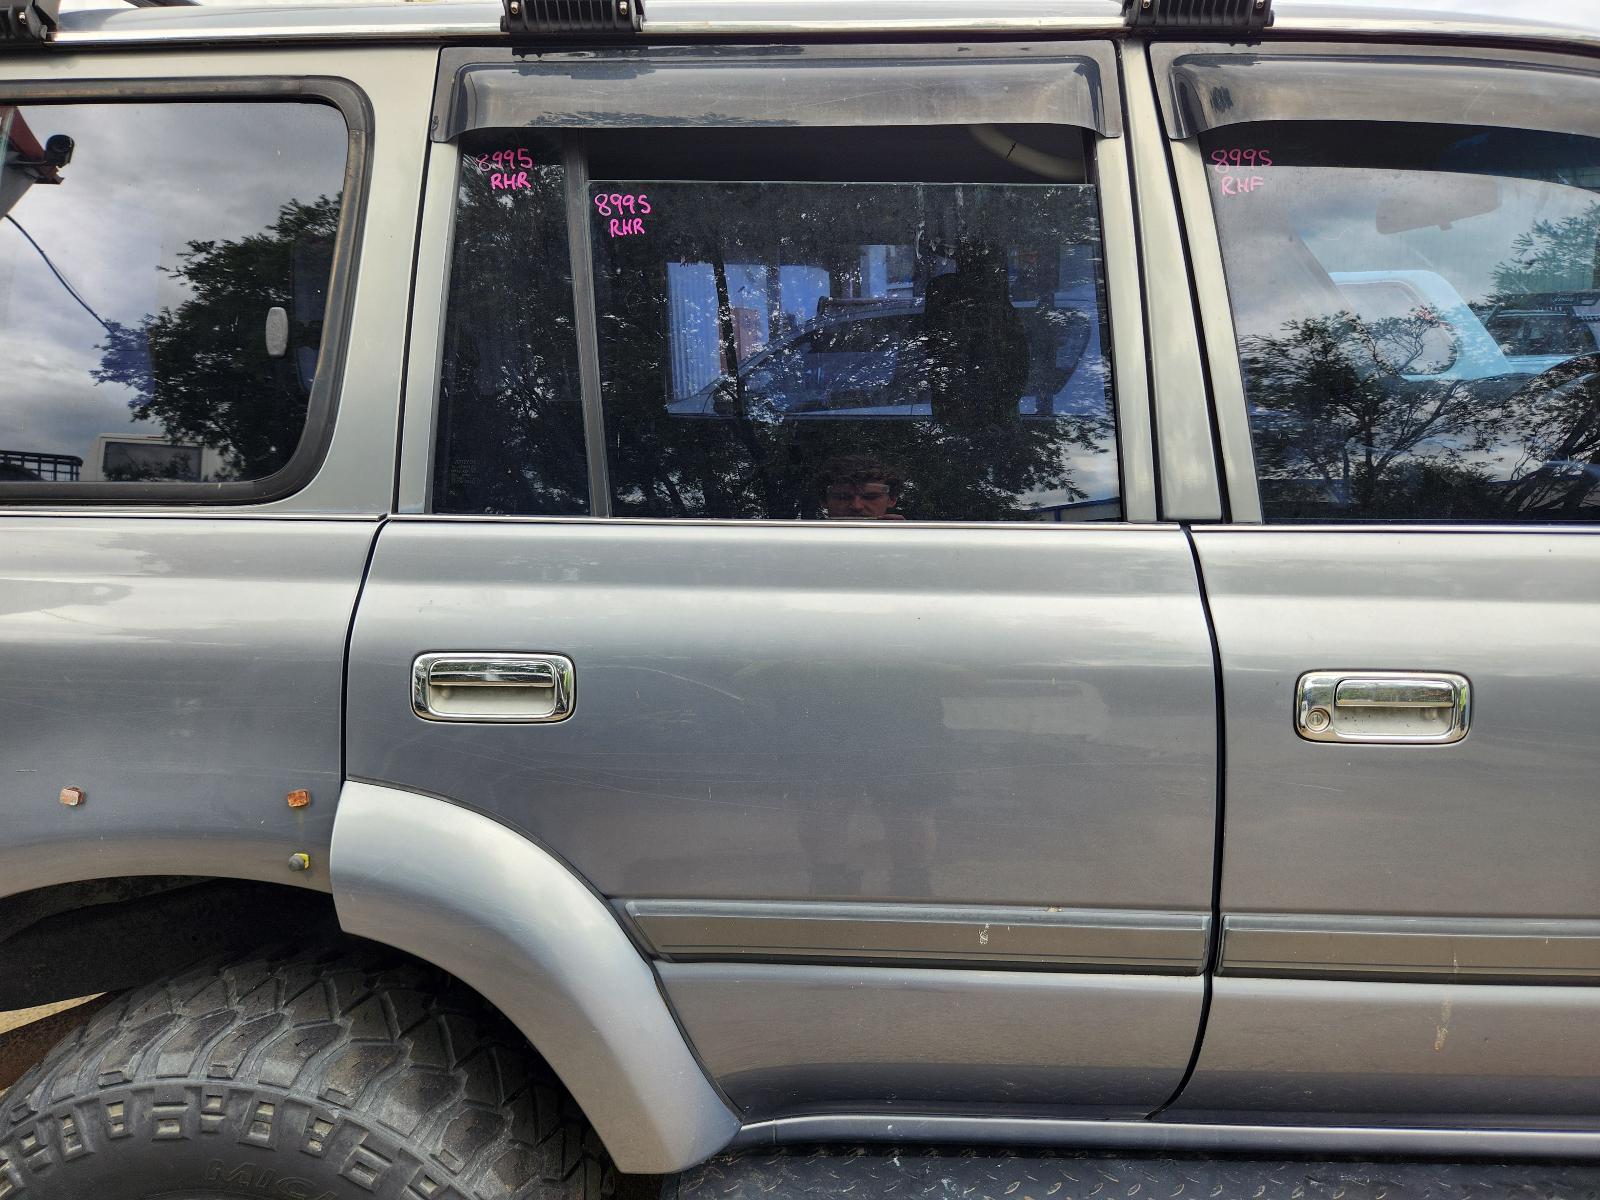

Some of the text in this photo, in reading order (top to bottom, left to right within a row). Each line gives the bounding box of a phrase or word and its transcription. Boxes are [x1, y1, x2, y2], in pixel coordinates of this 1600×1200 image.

[475, 148, 533, 172] 8995
[1211, 148, 1273, 174] 8995
[490, 171, 532, 190] RHR
[1221, 175, 1265, 196] RHF
[594, 193, 652, 217] 8995
[609, 217, 646, 238] RHR
